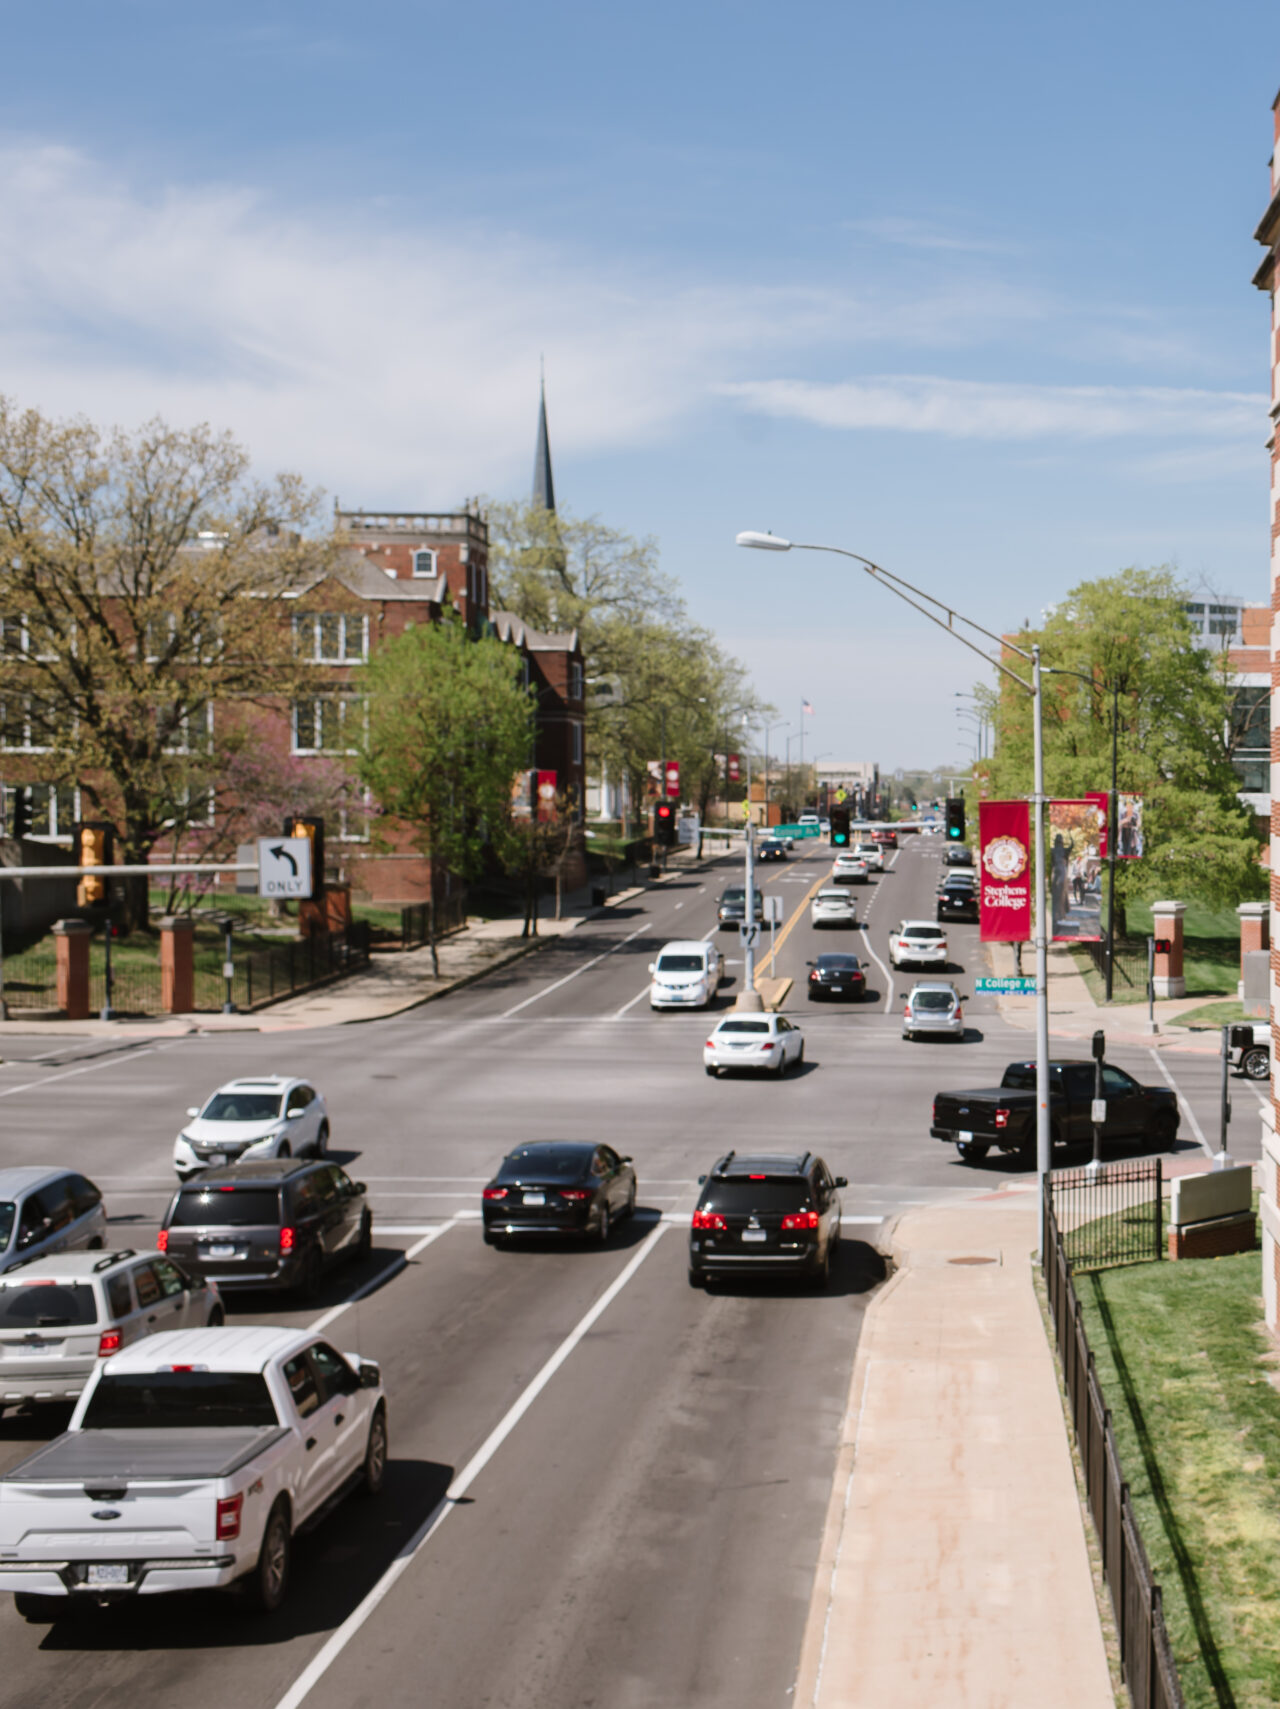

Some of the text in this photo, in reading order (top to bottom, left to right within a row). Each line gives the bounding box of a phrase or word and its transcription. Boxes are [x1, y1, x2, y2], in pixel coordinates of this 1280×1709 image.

[267, 881, 302, 892] ONLY
[984, 885, 1027, 898] Stephens
[984, 895, 1027, 910] College
[976, 979, 982, 988] N
[985, 979, 1021, 990] College
